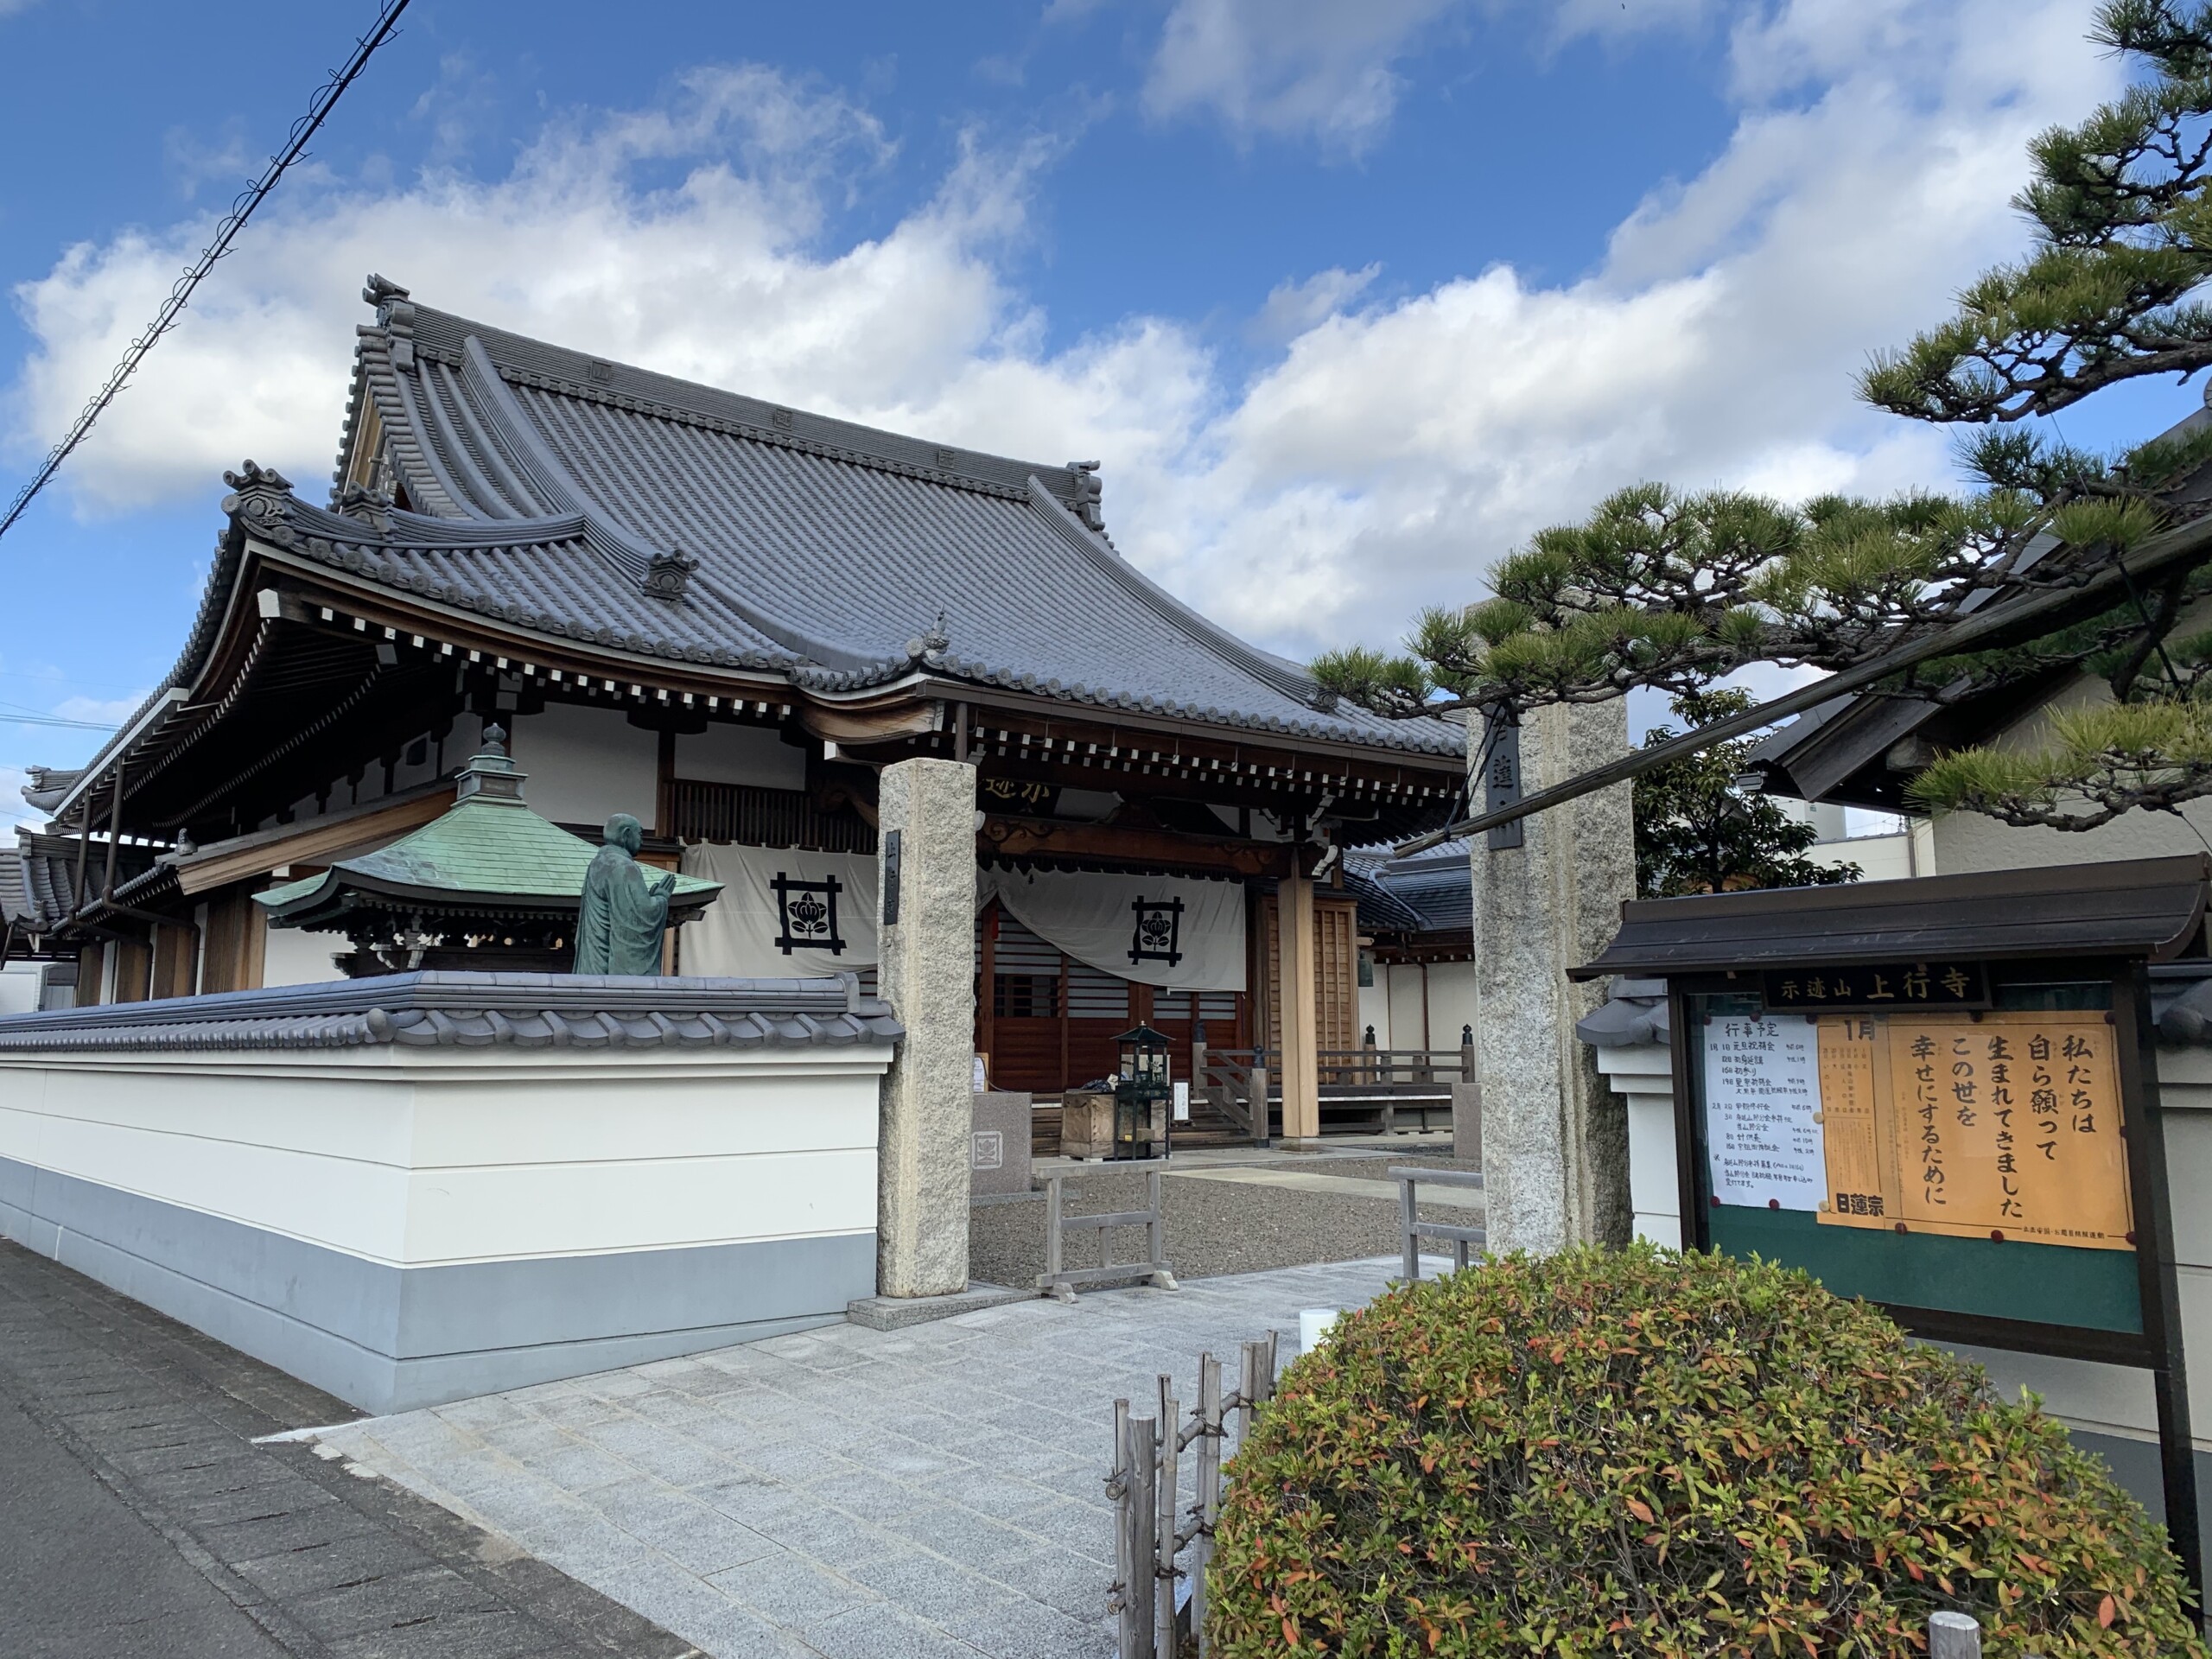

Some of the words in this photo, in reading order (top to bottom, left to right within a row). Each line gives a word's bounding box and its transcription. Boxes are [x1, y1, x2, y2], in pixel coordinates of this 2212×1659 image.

[1866, 966, 1971, 1000] 上行寺
[1725, 1021, 1780, 1038] 行事予定
[1844, 1020, 1876, 1042] 1月
[1910, 1034, 1947, 1205] 幸せにするために
[1951, 1038, 1978, 1127] この世を
[1987, 1035, 2023, 1218] 生まれてきました
[2027, 1033, 2059, 1161] 自ら願って
[2062, 1034, 2097, 1134] 私たちは
[1836, 1192, 1885, 1217] 日蓮宗
